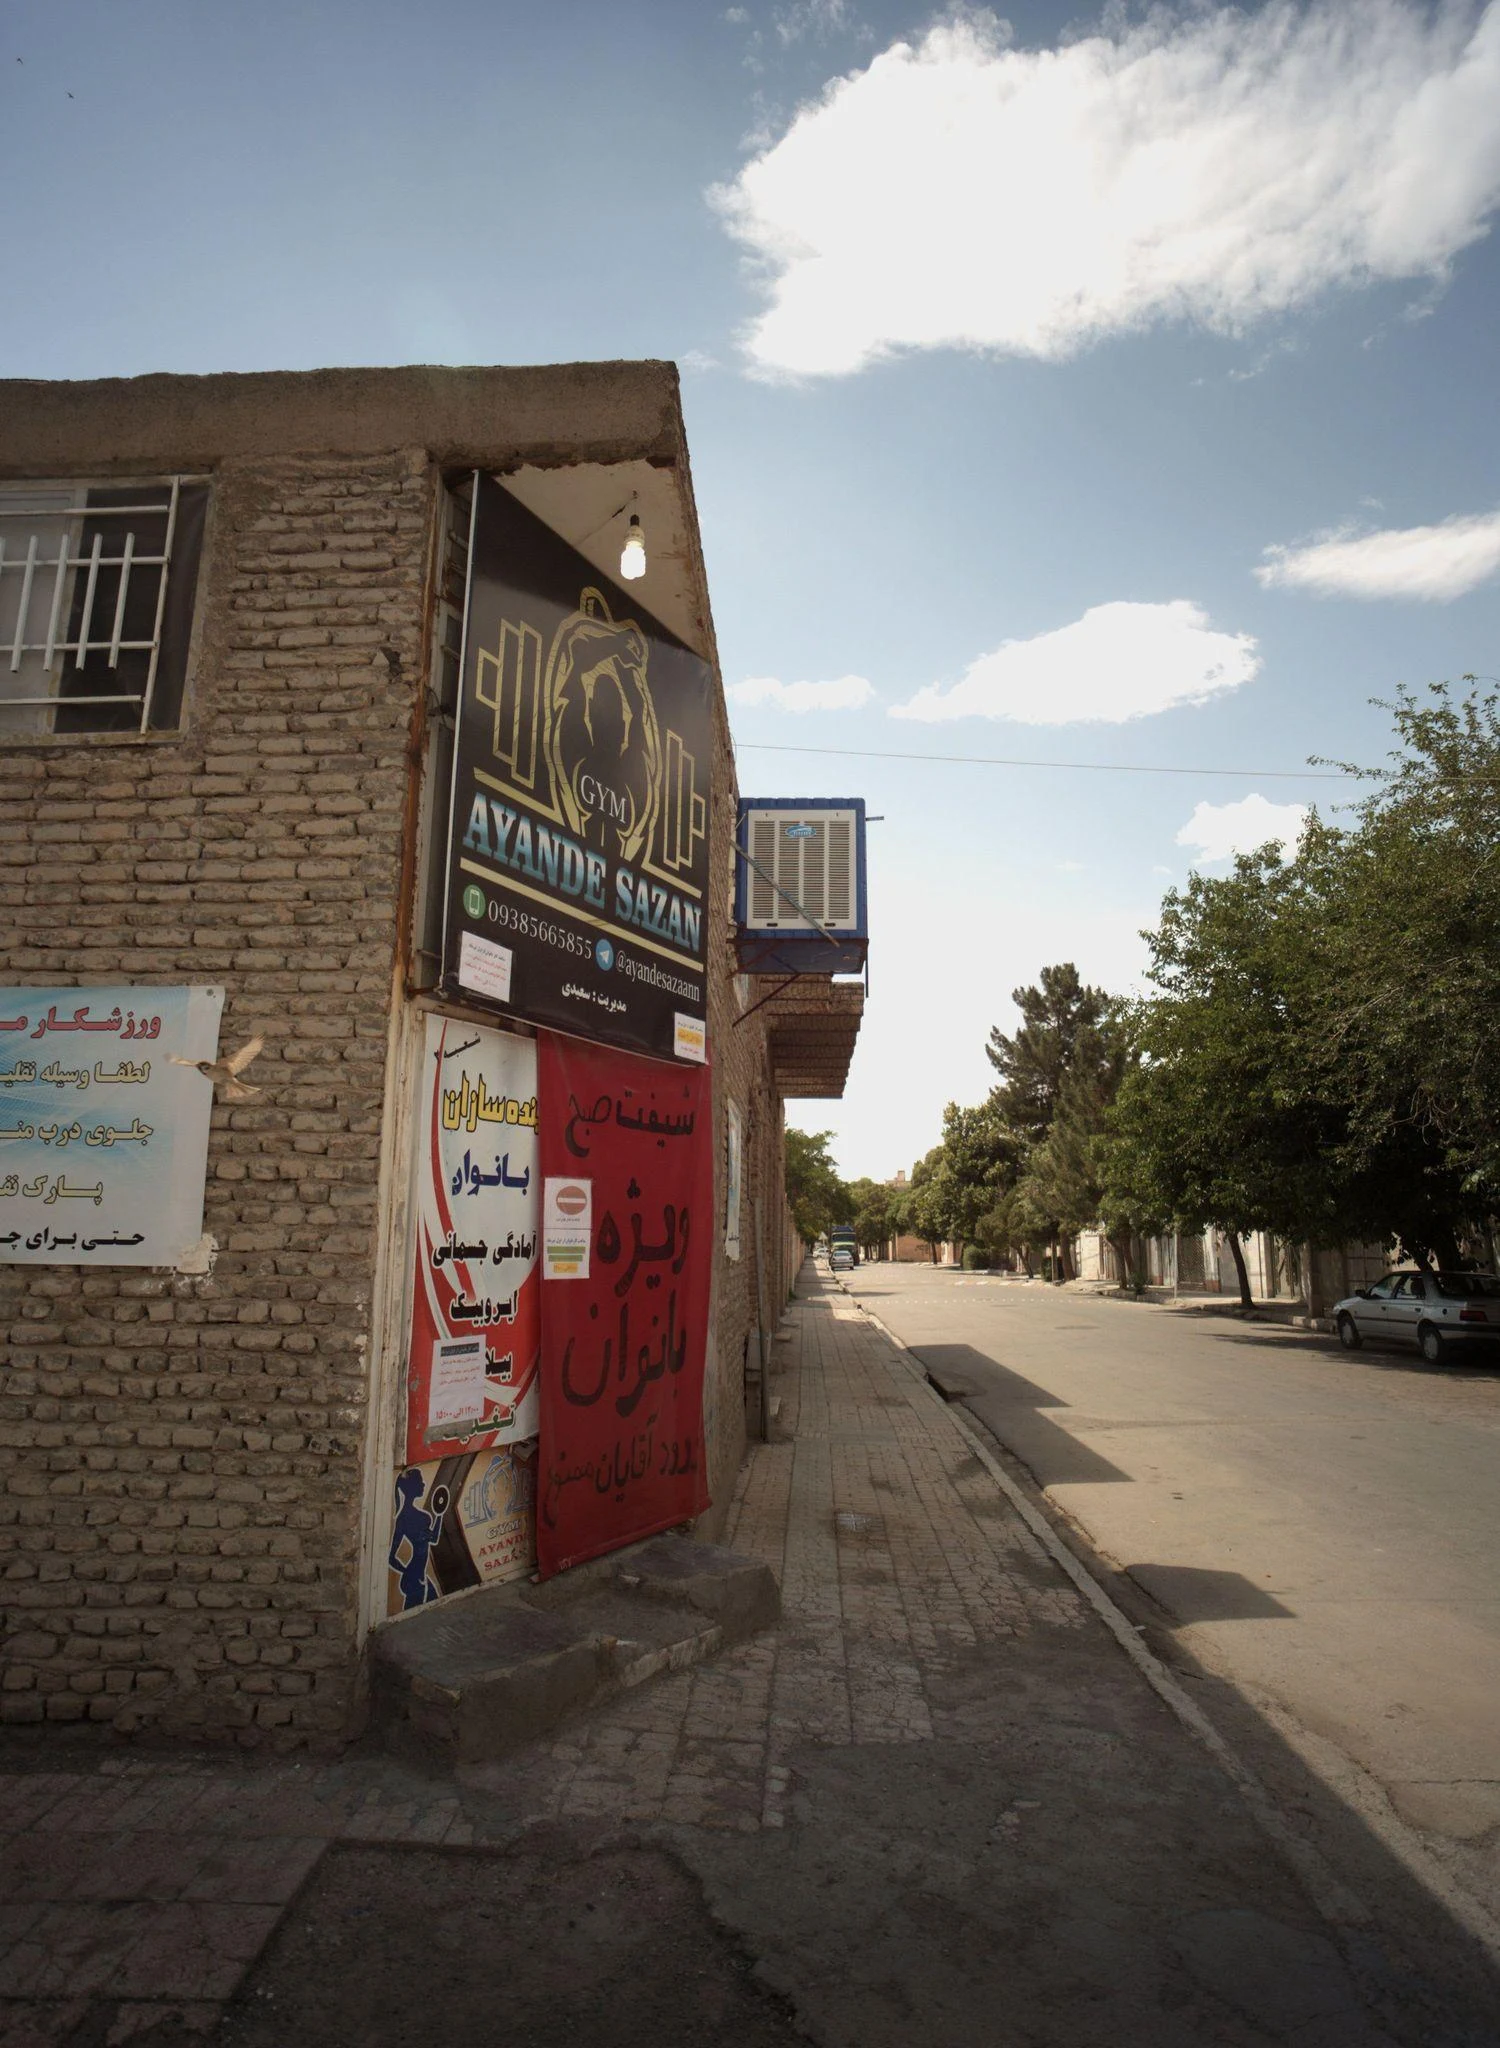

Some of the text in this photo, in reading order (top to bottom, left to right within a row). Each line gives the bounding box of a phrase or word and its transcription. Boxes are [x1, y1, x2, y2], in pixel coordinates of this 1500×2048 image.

[580, 775, 626, 824] GYM
[462, 792, 702, 952] AYANDE SAZAN
[488, 900, 592, 959] 09385665855
[561, 983, 590, 1000] سعیدی
[615, 950, 701, 1002] @ayandesazaann
[31, 1006, 161, 1039] ورزشکار
[0, 1061, 151, 1089] لطفا وسیله نقلی
[0, 1118, 153, 1146] جلوی درب من
[451, 1149, 530, 1196] بانوان
[22, 1175, 103, 1205] پارک
[26, 1227, 77, 1250] برای
[81, 1230, 145, 1250] حتی
[433, 1231, 537, 1267] آمادگی جسمانی
[451, 1290, 518, 1325] ایروبیک
[562, 1289, 687, 1417] بانوان
[486, 1519, 521, 1540] GYM
